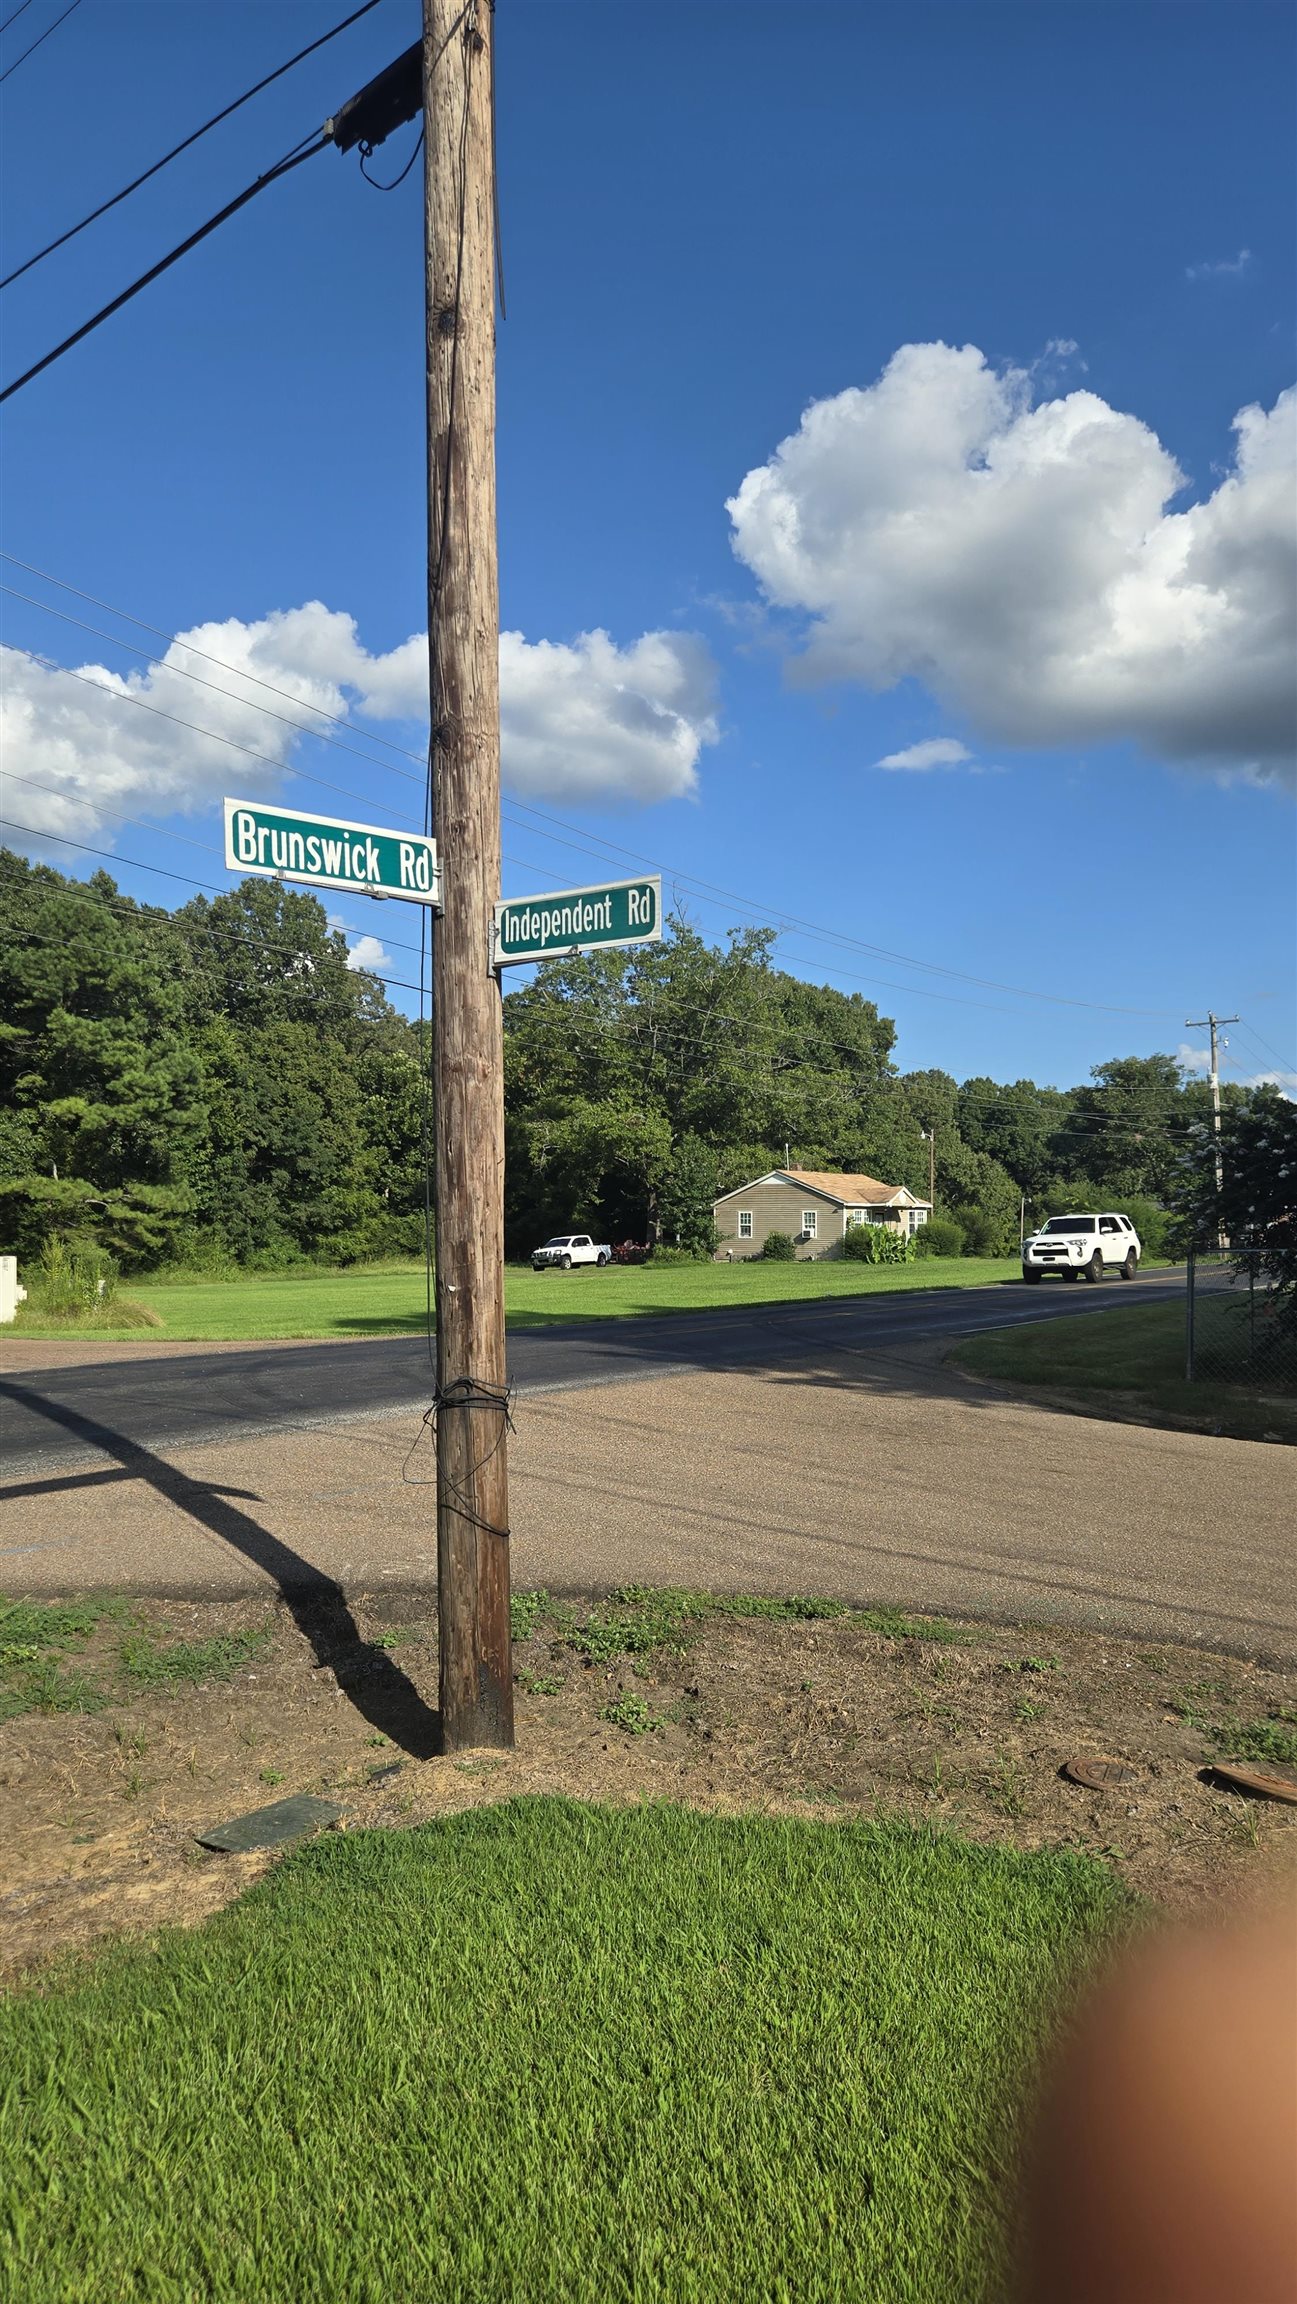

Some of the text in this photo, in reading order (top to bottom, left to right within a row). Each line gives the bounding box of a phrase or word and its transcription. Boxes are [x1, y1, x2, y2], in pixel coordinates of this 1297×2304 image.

[237, 812, 430, 891] Brunswick Rd
[505, 888, 650, 947] Independent Rd
